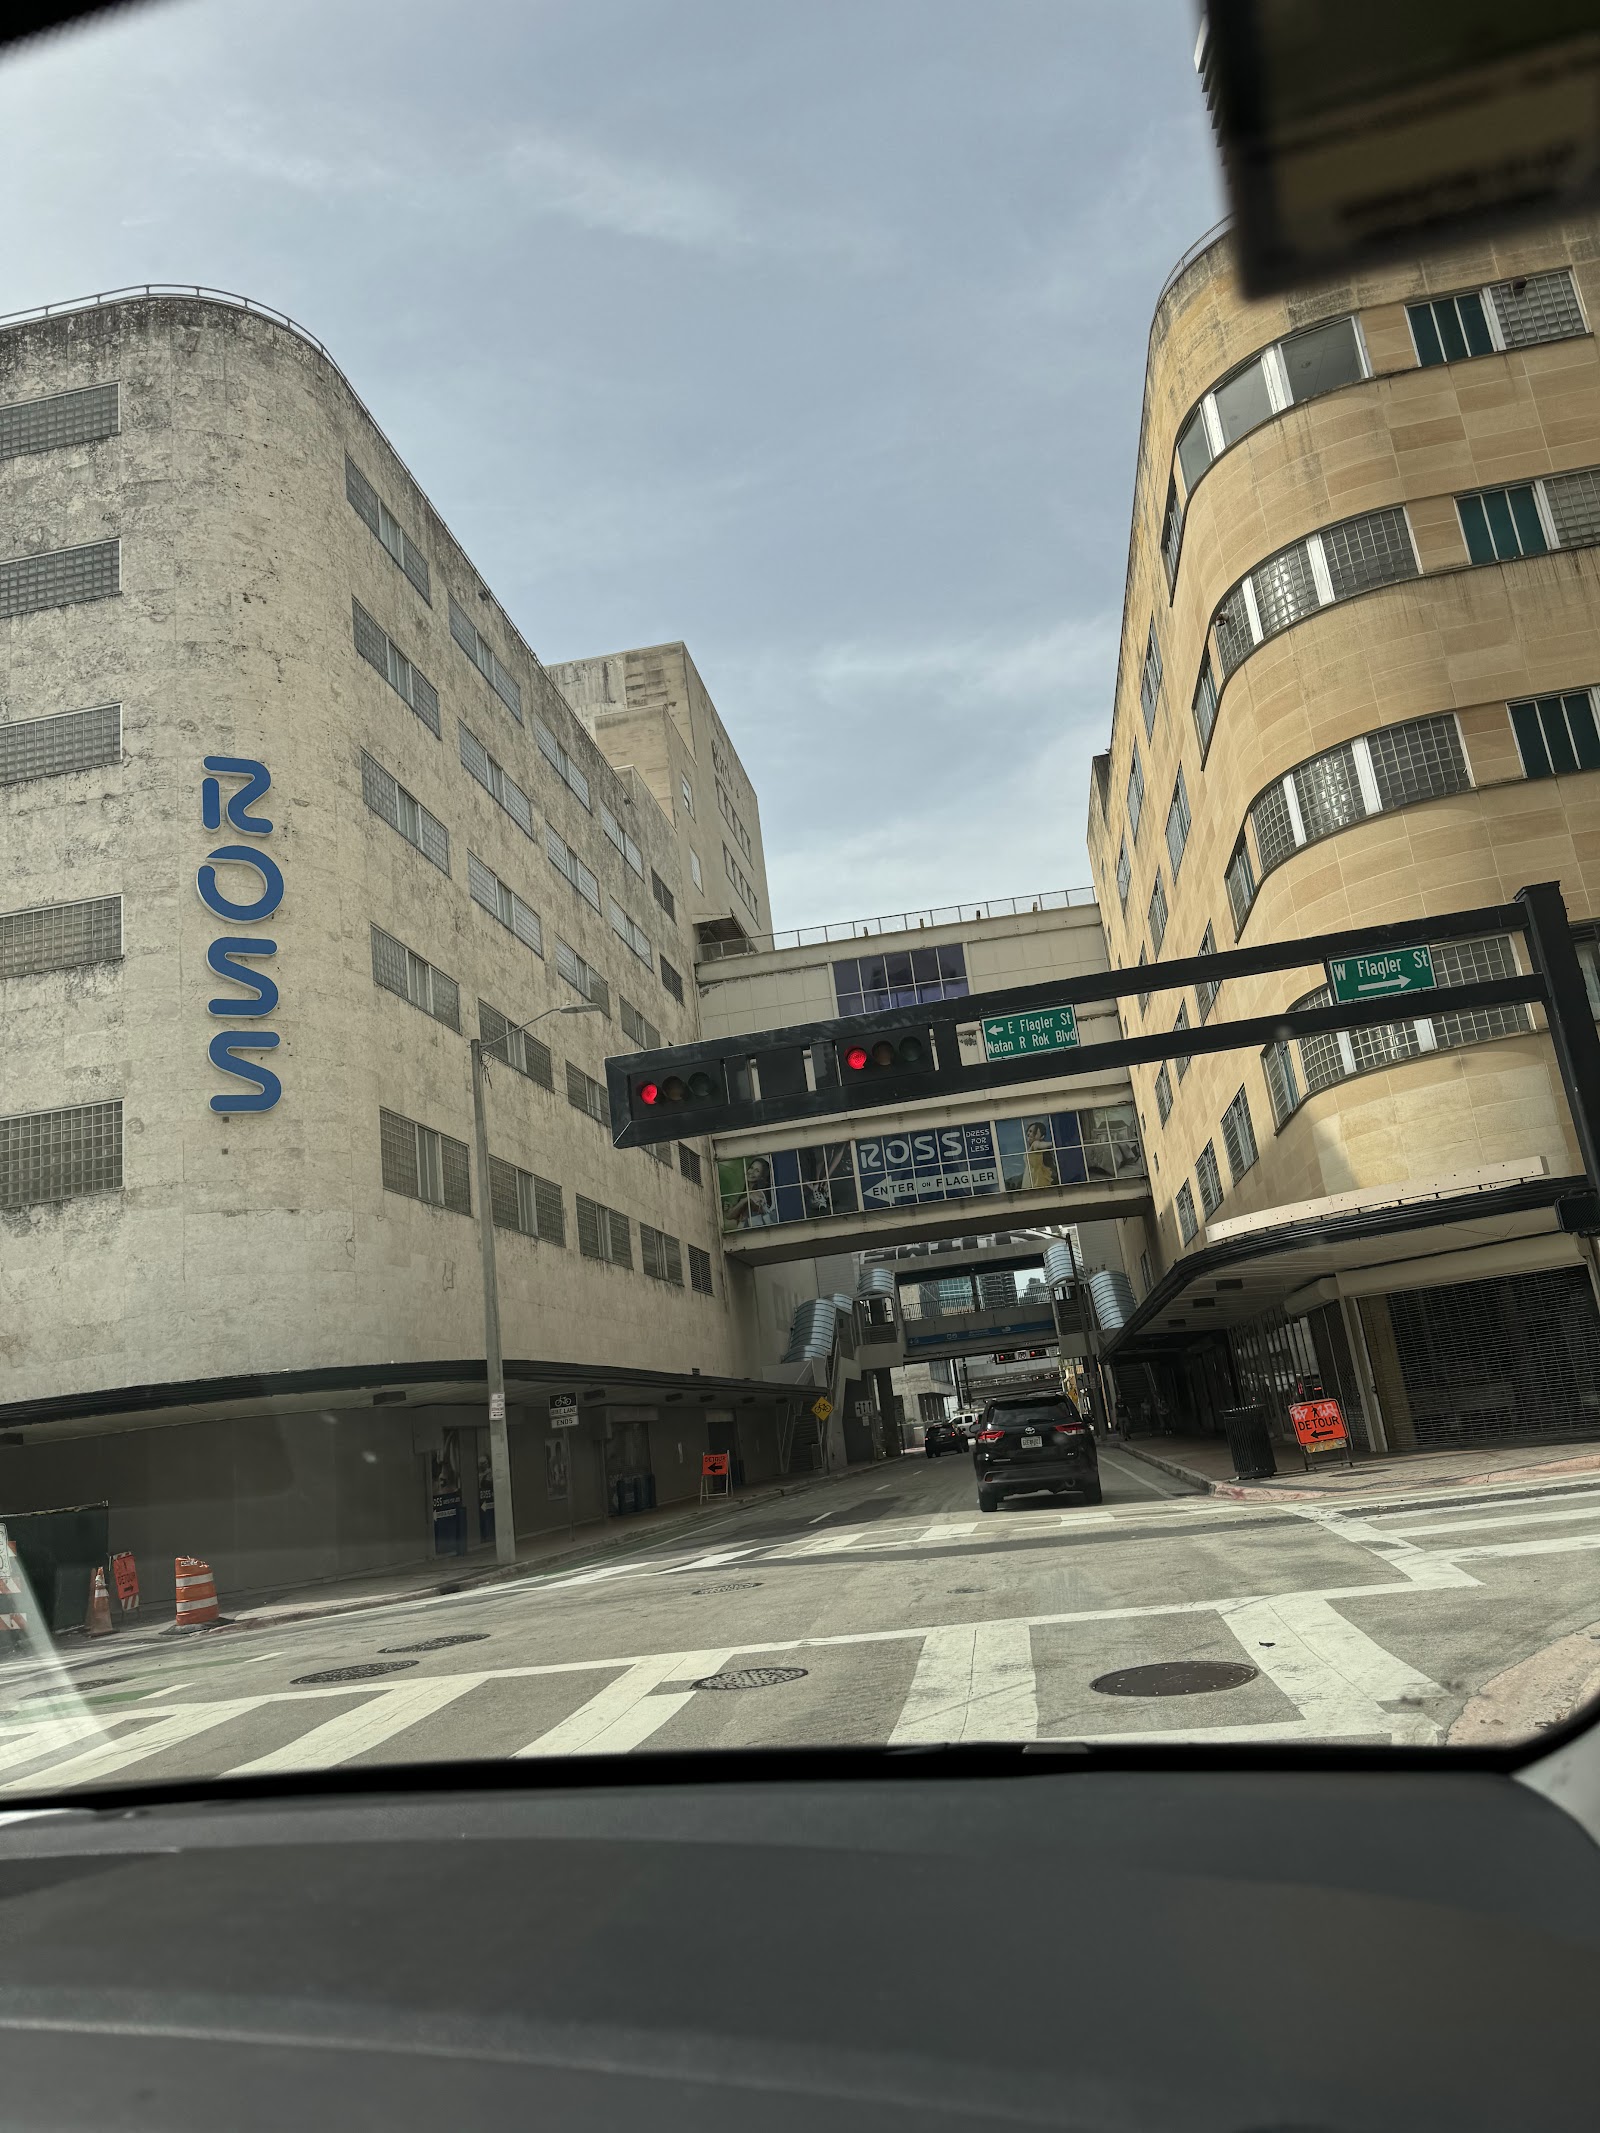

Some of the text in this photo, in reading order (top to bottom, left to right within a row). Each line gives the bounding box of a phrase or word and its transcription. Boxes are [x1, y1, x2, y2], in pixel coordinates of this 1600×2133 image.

[196, 755, 284, 1113] ROSS
[1333, 950, 1429, 981] W Flagler St
[1007, 1011, 1072, 1035] E Flagler St
[987, 1027, 1077, 1054] Natan R Rok Blvd
[965, 1128, 990, 1138] DRESS
[971, 1137, 987, 1145] FOR
[859, 1131, 963, 1169] ROSS
[970, 1144, 990, 1153] LESS
[872, 1182, 915, 1197] ENTER
[936, 1171, 995, 1188] FLAGLER
[556, 1418, 573, 1426] ENDS
[1298, 1415, 1340, 1431] DETOUR
[117, 1571, 136, 1586] DETOUR
